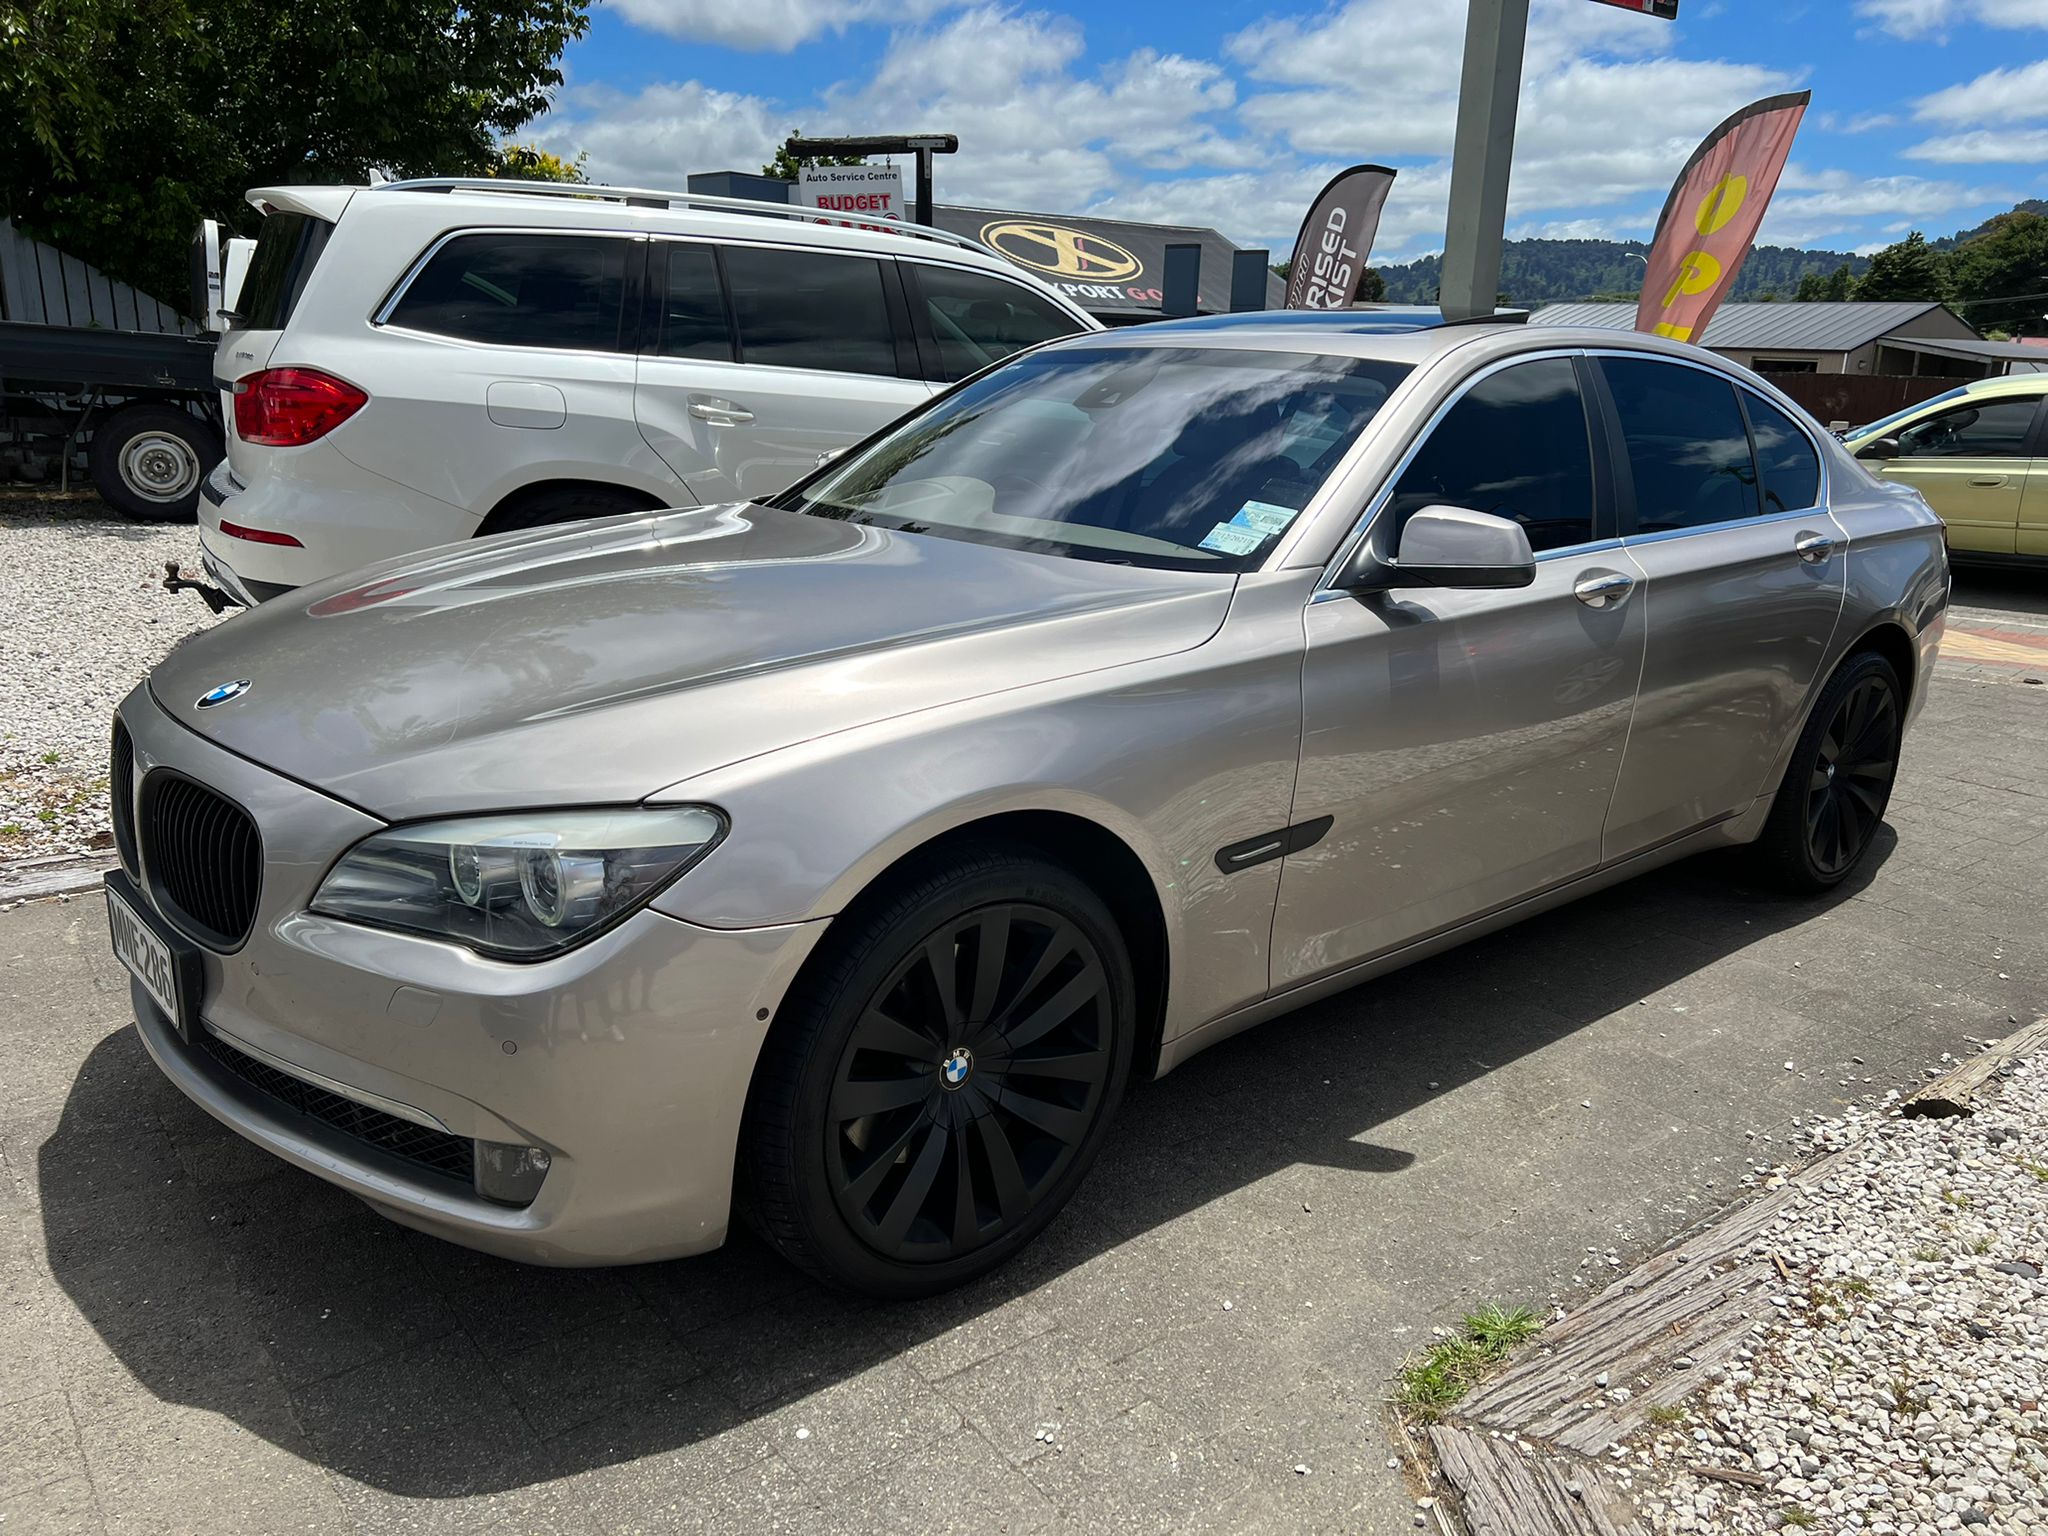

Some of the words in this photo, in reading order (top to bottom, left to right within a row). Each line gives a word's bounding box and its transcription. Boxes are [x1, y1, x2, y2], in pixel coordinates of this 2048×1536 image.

[806, 173, 828, 182] Auto
[830, 172, 865, 181] Service
[867, 172, 897, 180] Centre
[816, 193, 891, 211] BUDGET
[111, 899, 173, 1010] MNE286
